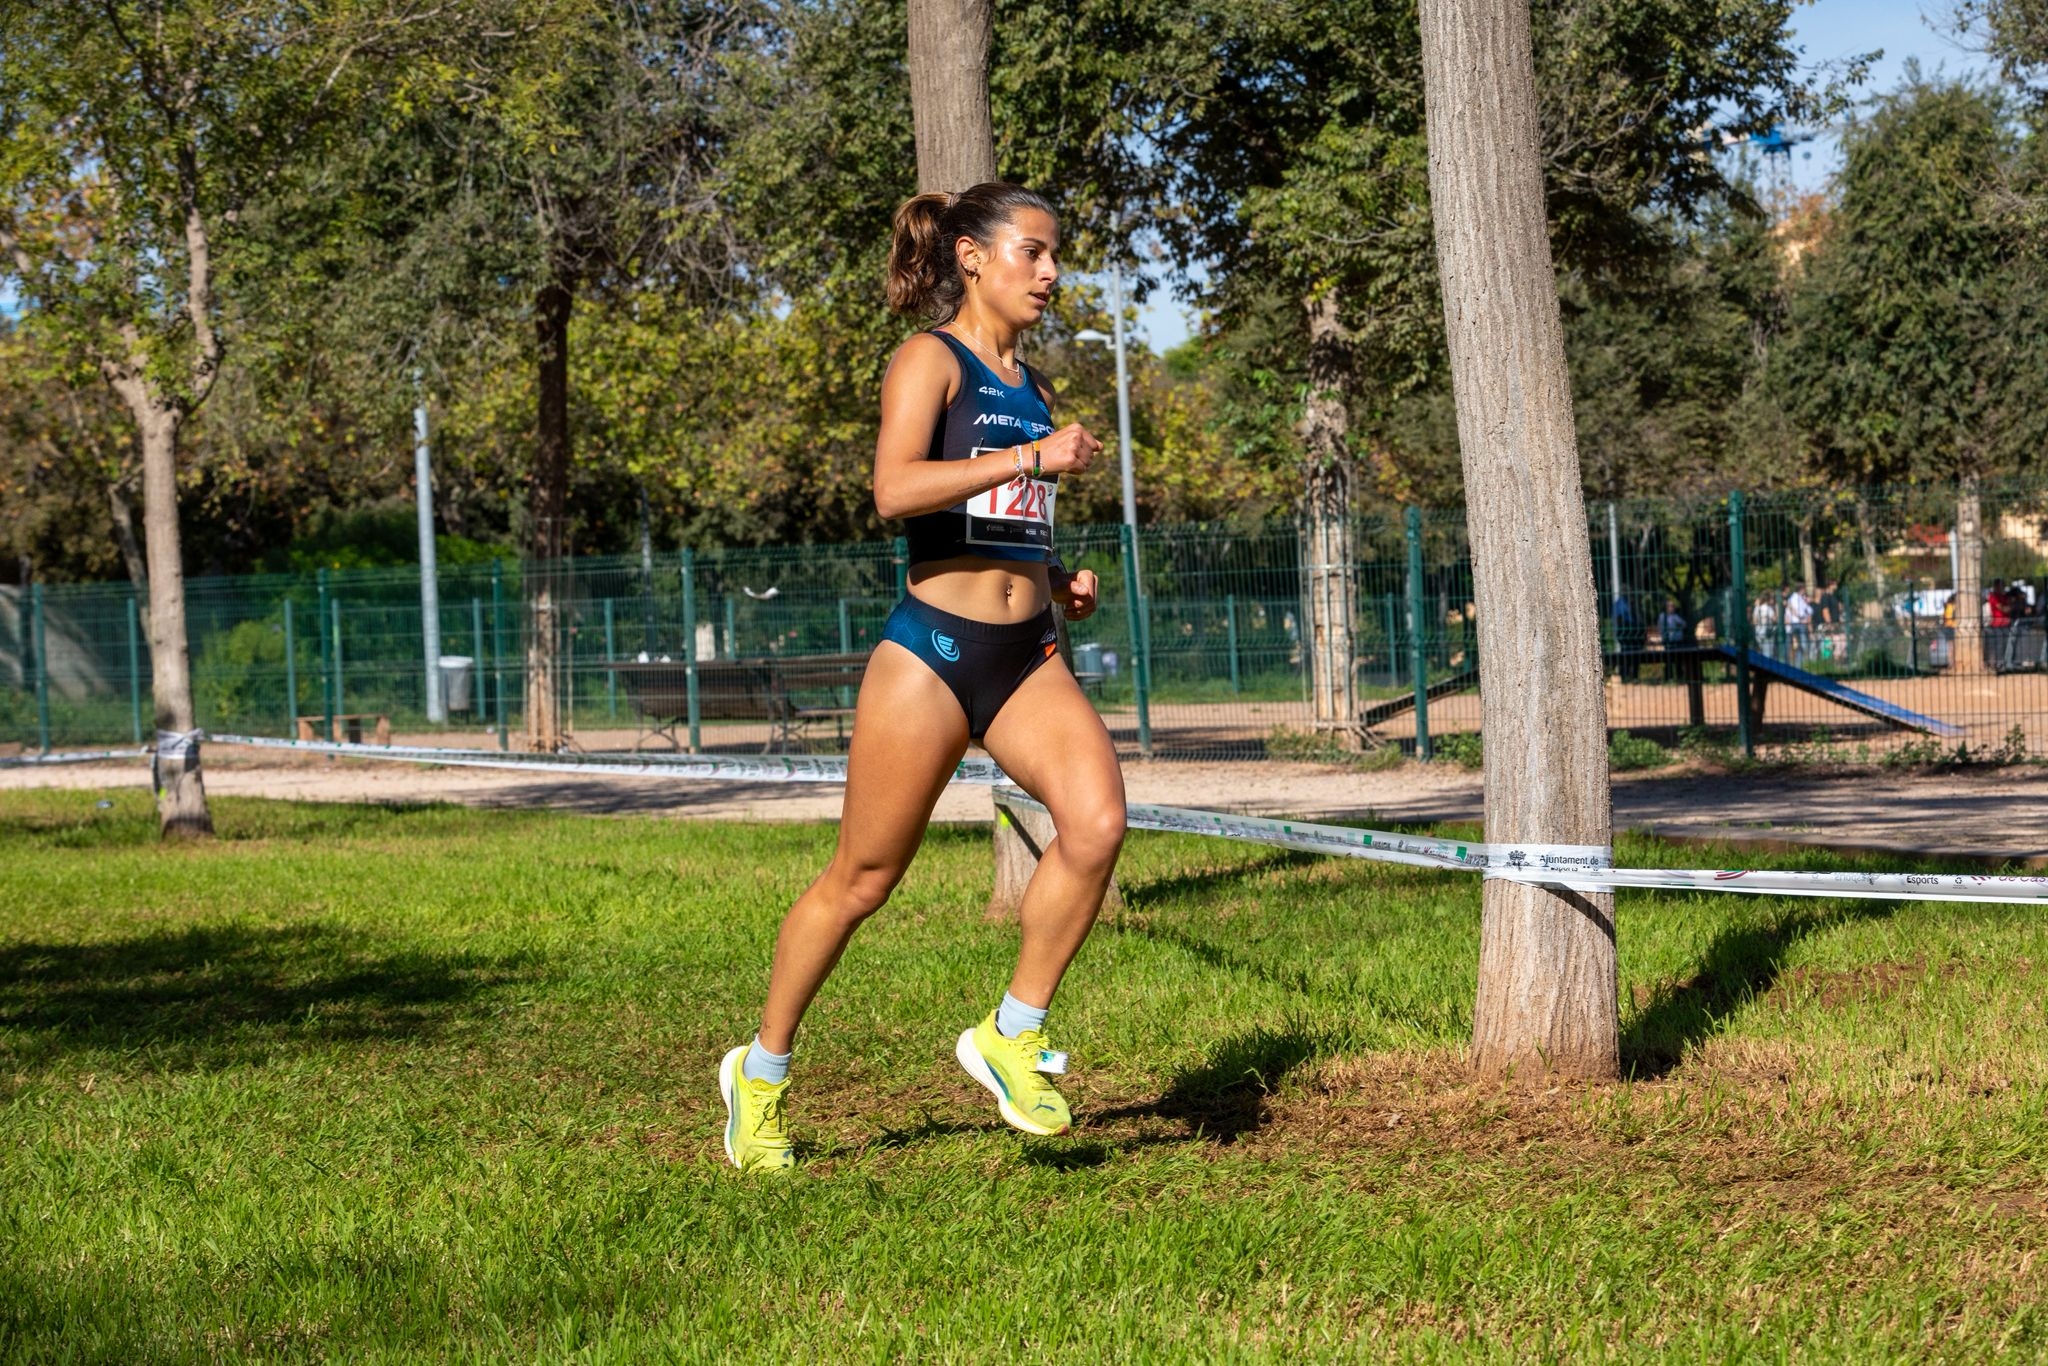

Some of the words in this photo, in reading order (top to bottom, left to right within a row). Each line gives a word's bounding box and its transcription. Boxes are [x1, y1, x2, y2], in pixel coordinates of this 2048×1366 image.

[978, 386, 1005, 398] 42K
[989, 480, 1046, 520] 1228
[1540, 855, 1588, 867] Ajuntament
[1590, 856, 1599, 865] de
[1907, 875, 1939, 886] Esports
